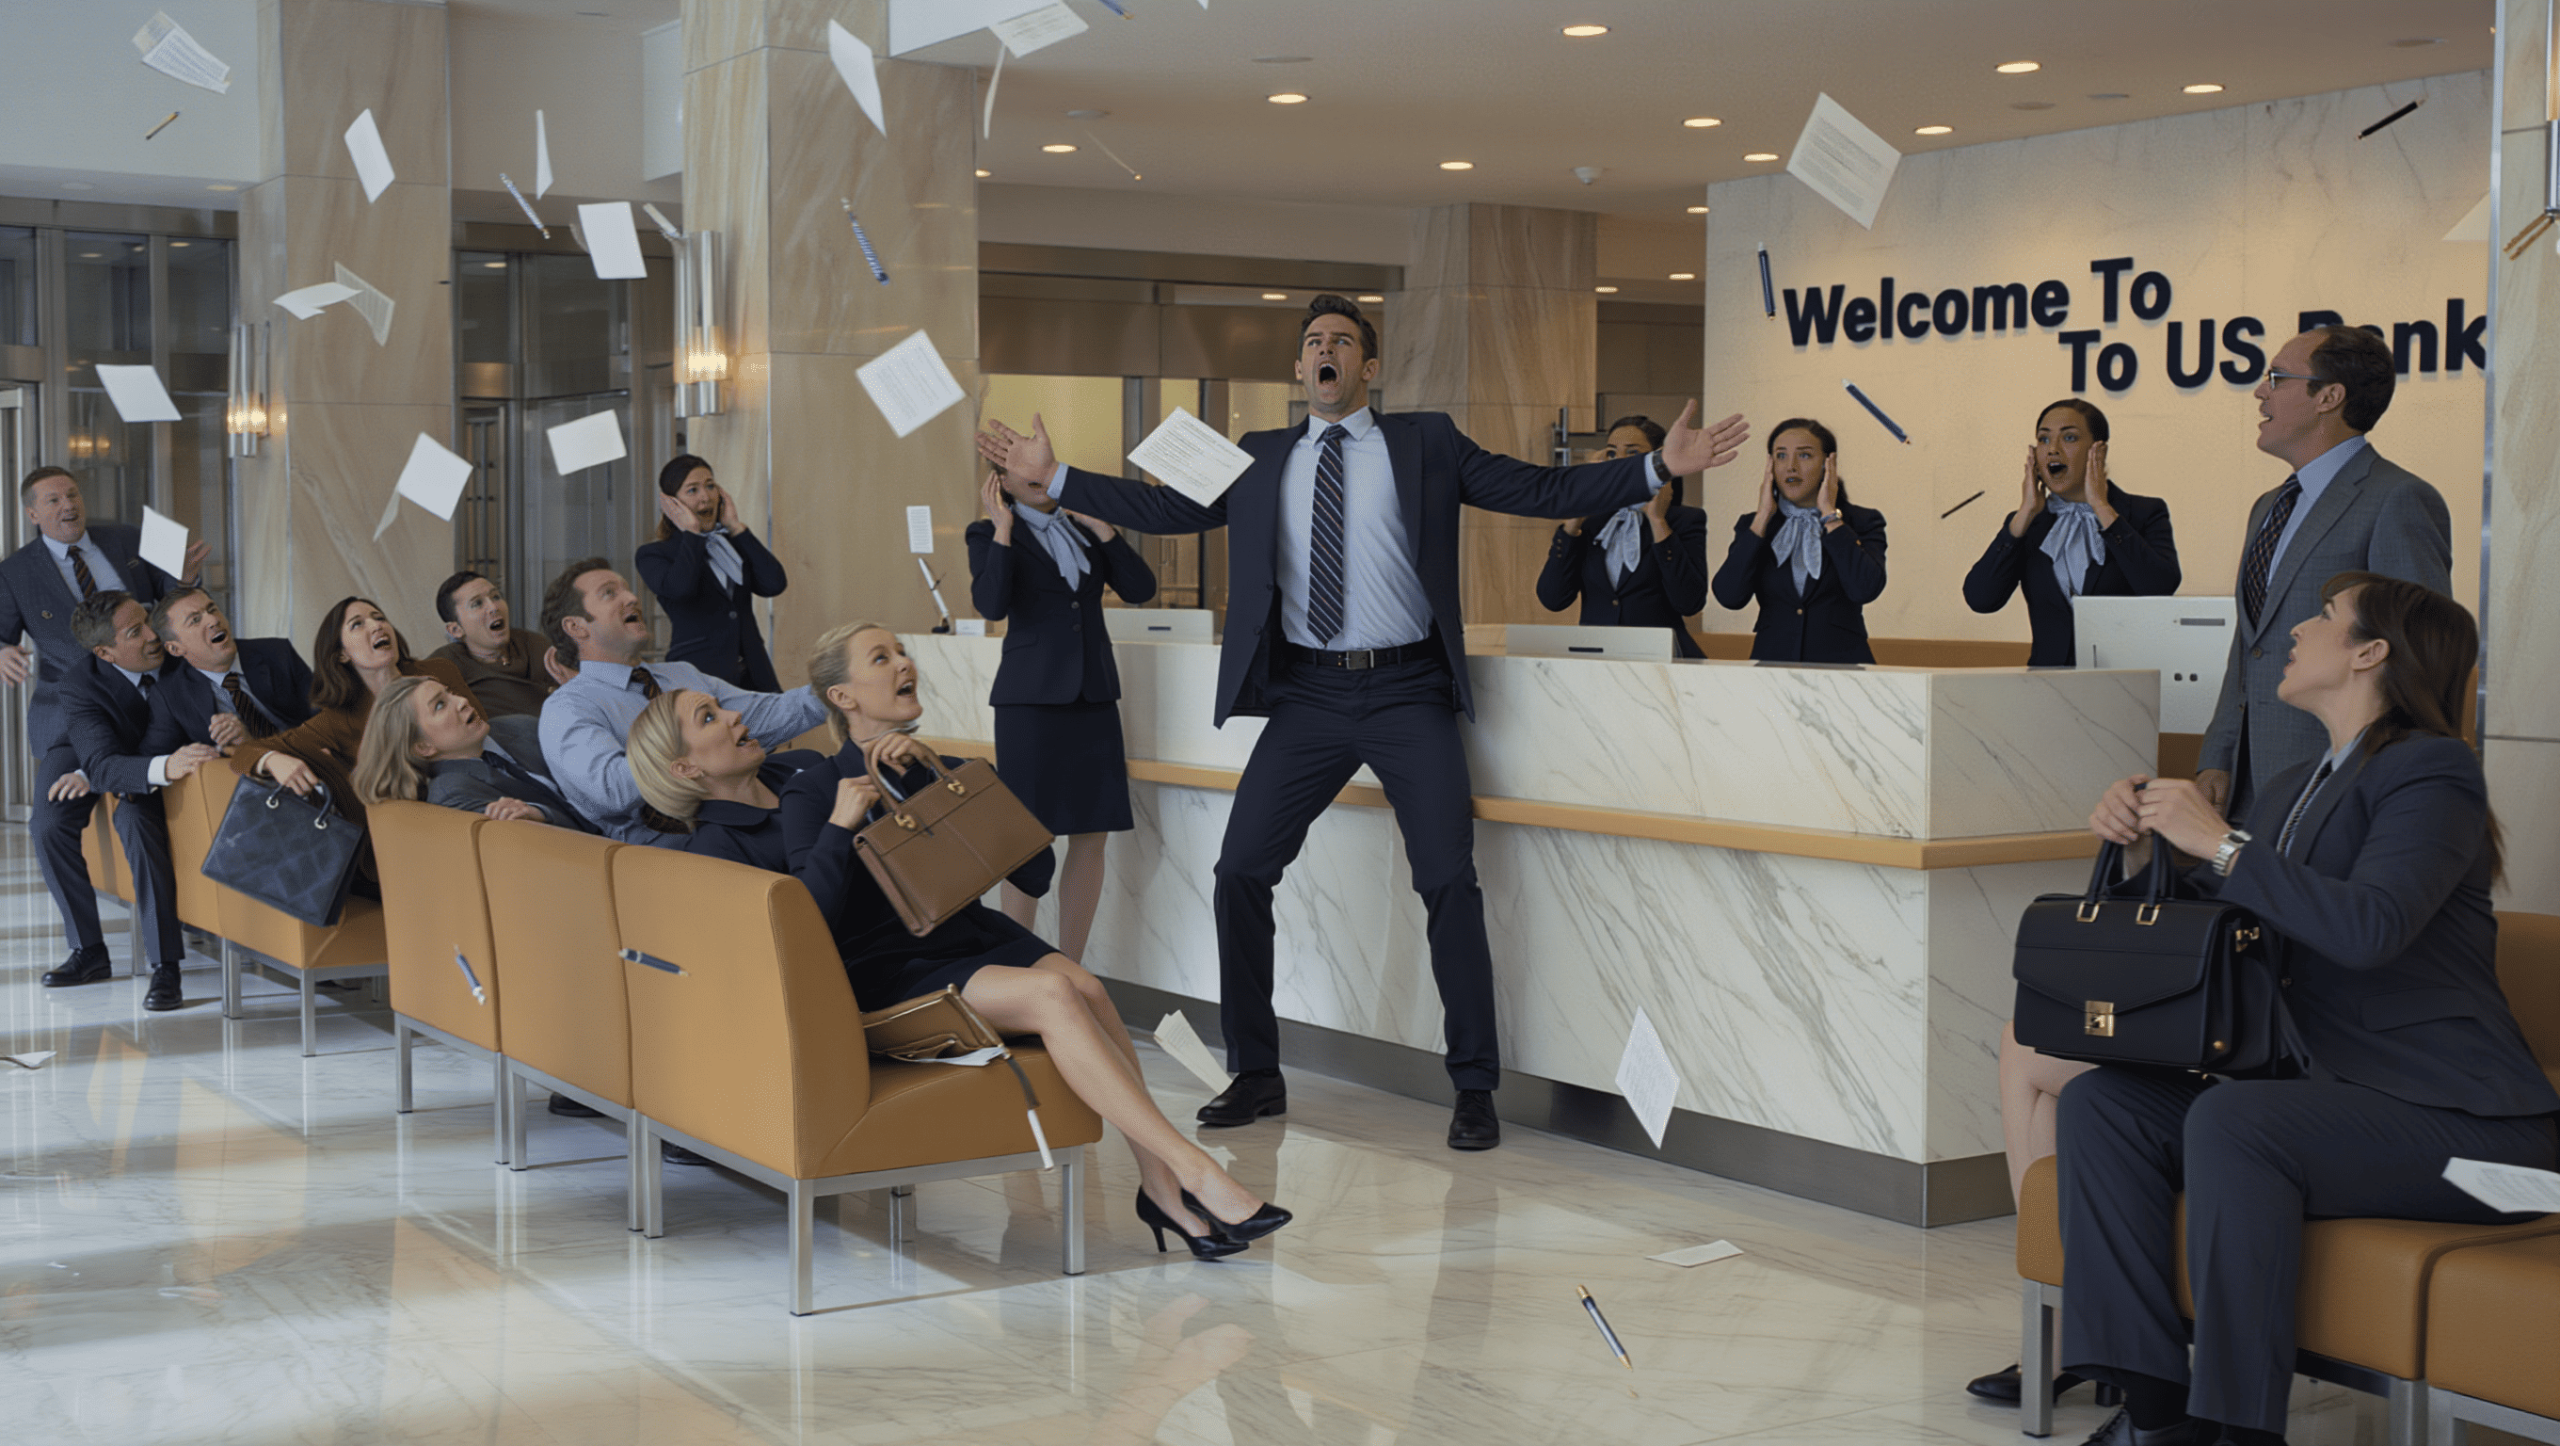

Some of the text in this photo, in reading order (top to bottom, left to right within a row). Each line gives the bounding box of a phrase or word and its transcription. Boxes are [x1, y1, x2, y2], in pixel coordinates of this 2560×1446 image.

[1782, 256, 2172, 347] Welcome To
[2058, 298, 2488, 393] To US nk
